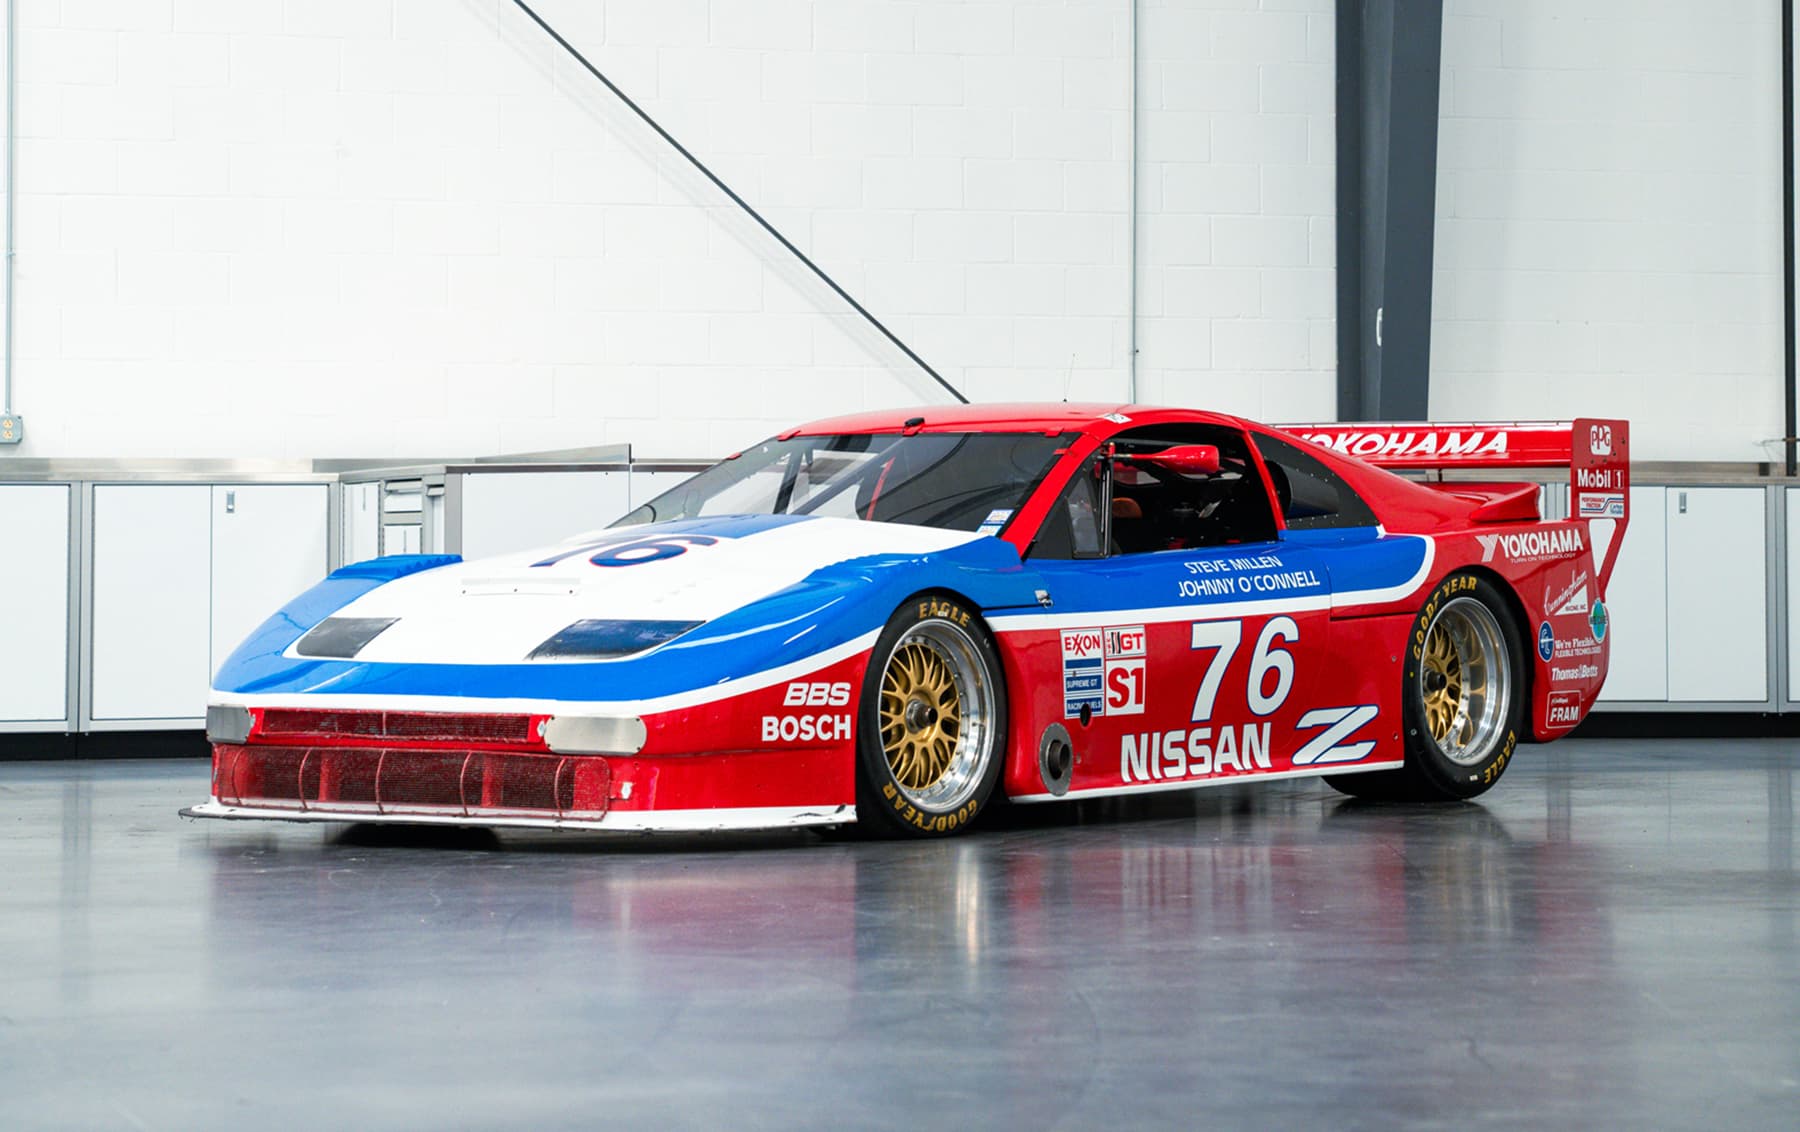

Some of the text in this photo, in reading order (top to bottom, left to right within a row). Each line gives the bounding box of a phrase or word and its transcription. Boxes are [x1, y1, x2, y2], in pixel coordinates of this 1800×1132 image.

[1591, 425, 1611, 450] PPG
[1577, 468, 1611, 488] Mobil
[1499, 528, 1584, 558] YOKOHAMA
[1184, 556, 1283, 574] STEVE MILLEN
[1179, 570, 1320, 597] JOHNNY O'CONNELL
[919, 599, 971, 627] EAGLE
[1413, 576, 1478, 660] GOODYEAR
[1064, 634, 1101, 656] EXXON
[1120, 633, 1144, 650] GT
[1191, 615, 1299, 722] 76
[783, 682, 851, 706] BBS
[1067, 679, 1090, 689] SUPREME
[1108, 667, 1144, 708] S1
[762, 714, 851, 741] BOSCH
[1549, 706, 1579, 722] FRAM
[1120, 722, 1272, 782] NISSAN
[1483, 729, 1516, 784] EAGLE
[883, 781, 978, 832] GOODYEAR
